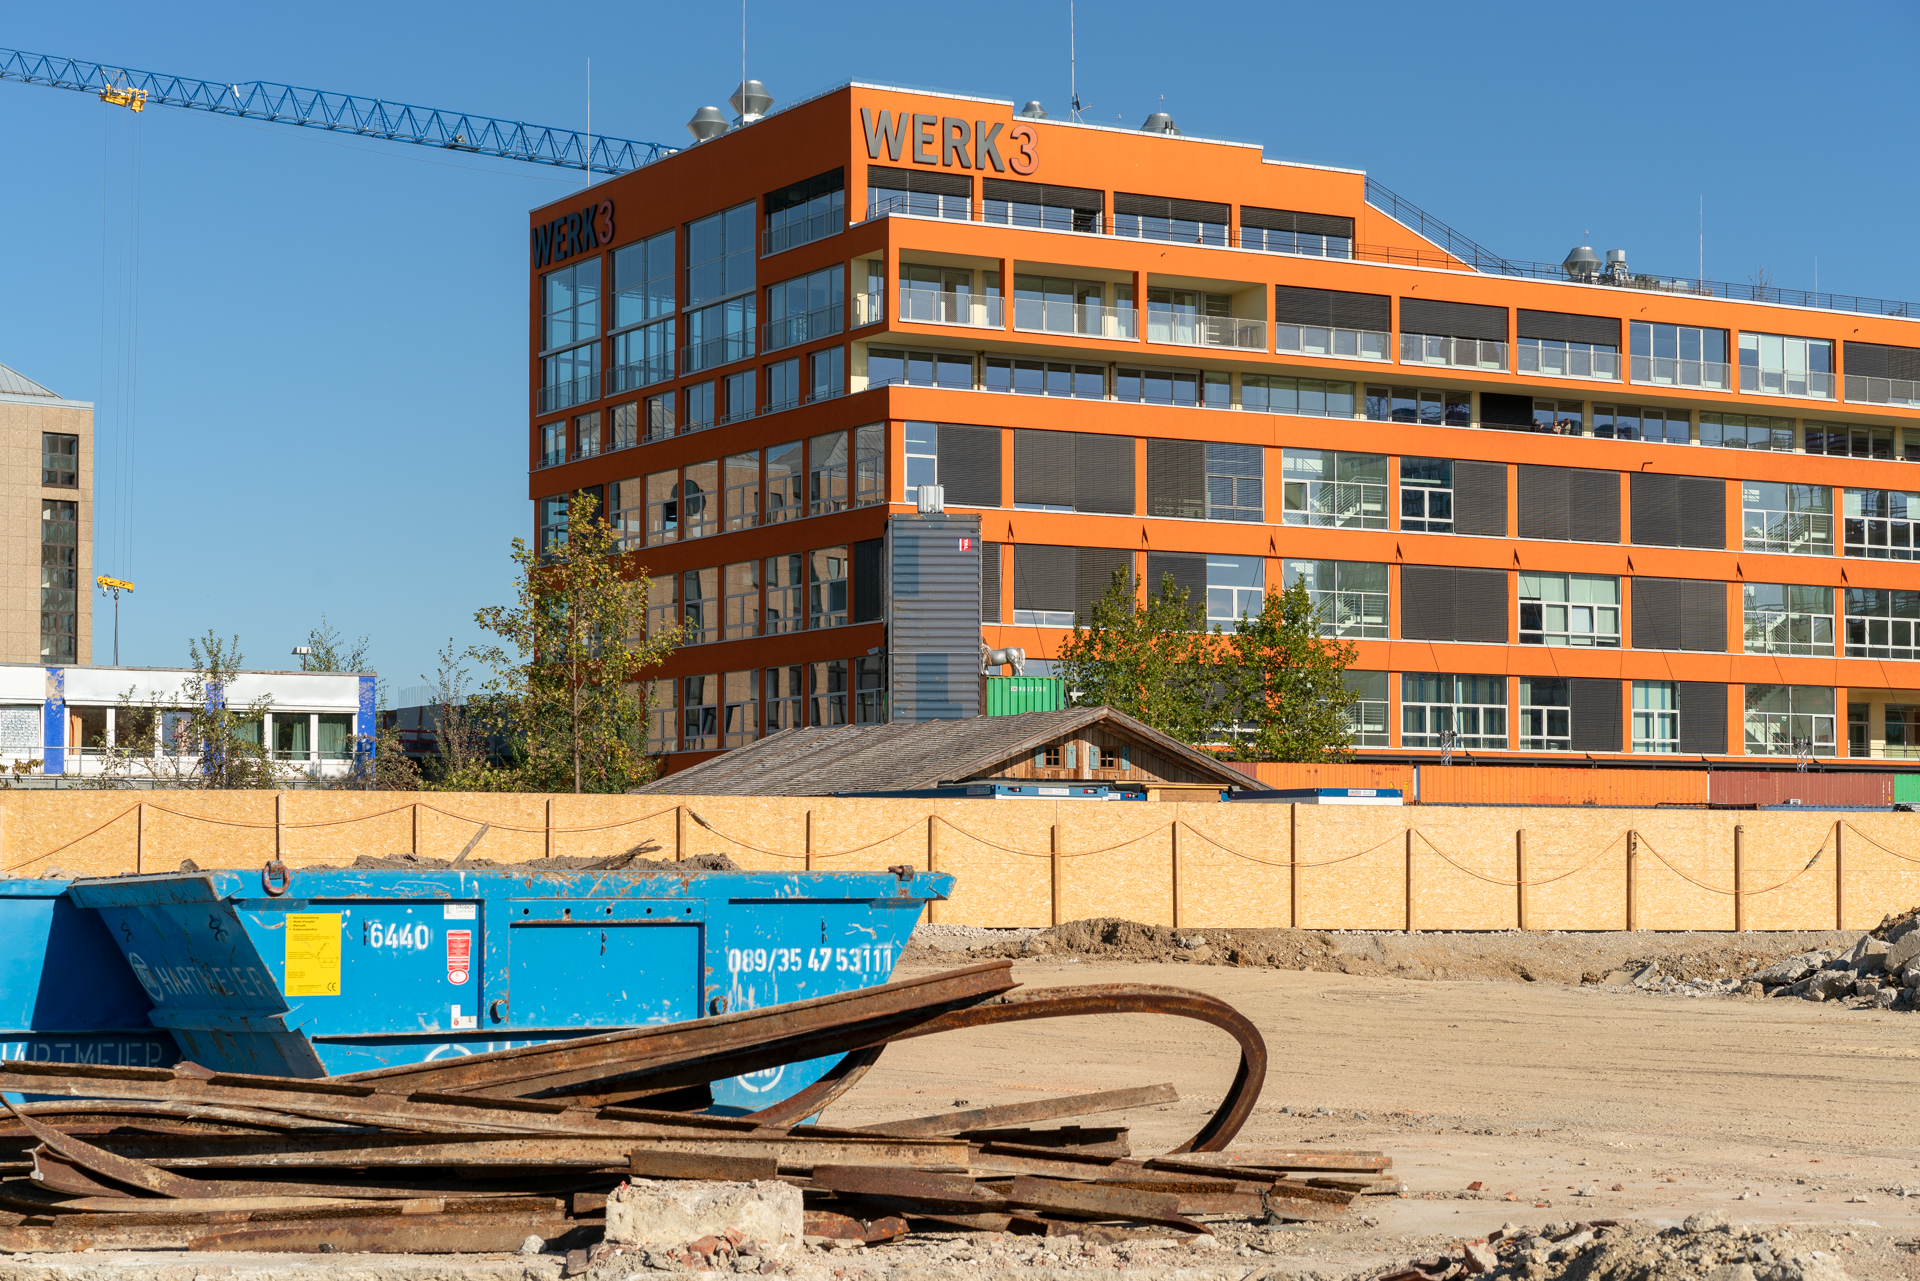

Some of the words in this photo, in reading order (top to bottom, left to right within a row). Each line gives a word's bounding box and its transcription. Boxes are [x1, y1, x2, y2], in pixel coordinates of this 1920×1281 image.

[370, 922, 429, 950] 6440
[728, 948, 802, 972] 089/35
[808, 948, 832, 972] 47
[155, 966, 271, 996] HARTMEIER
